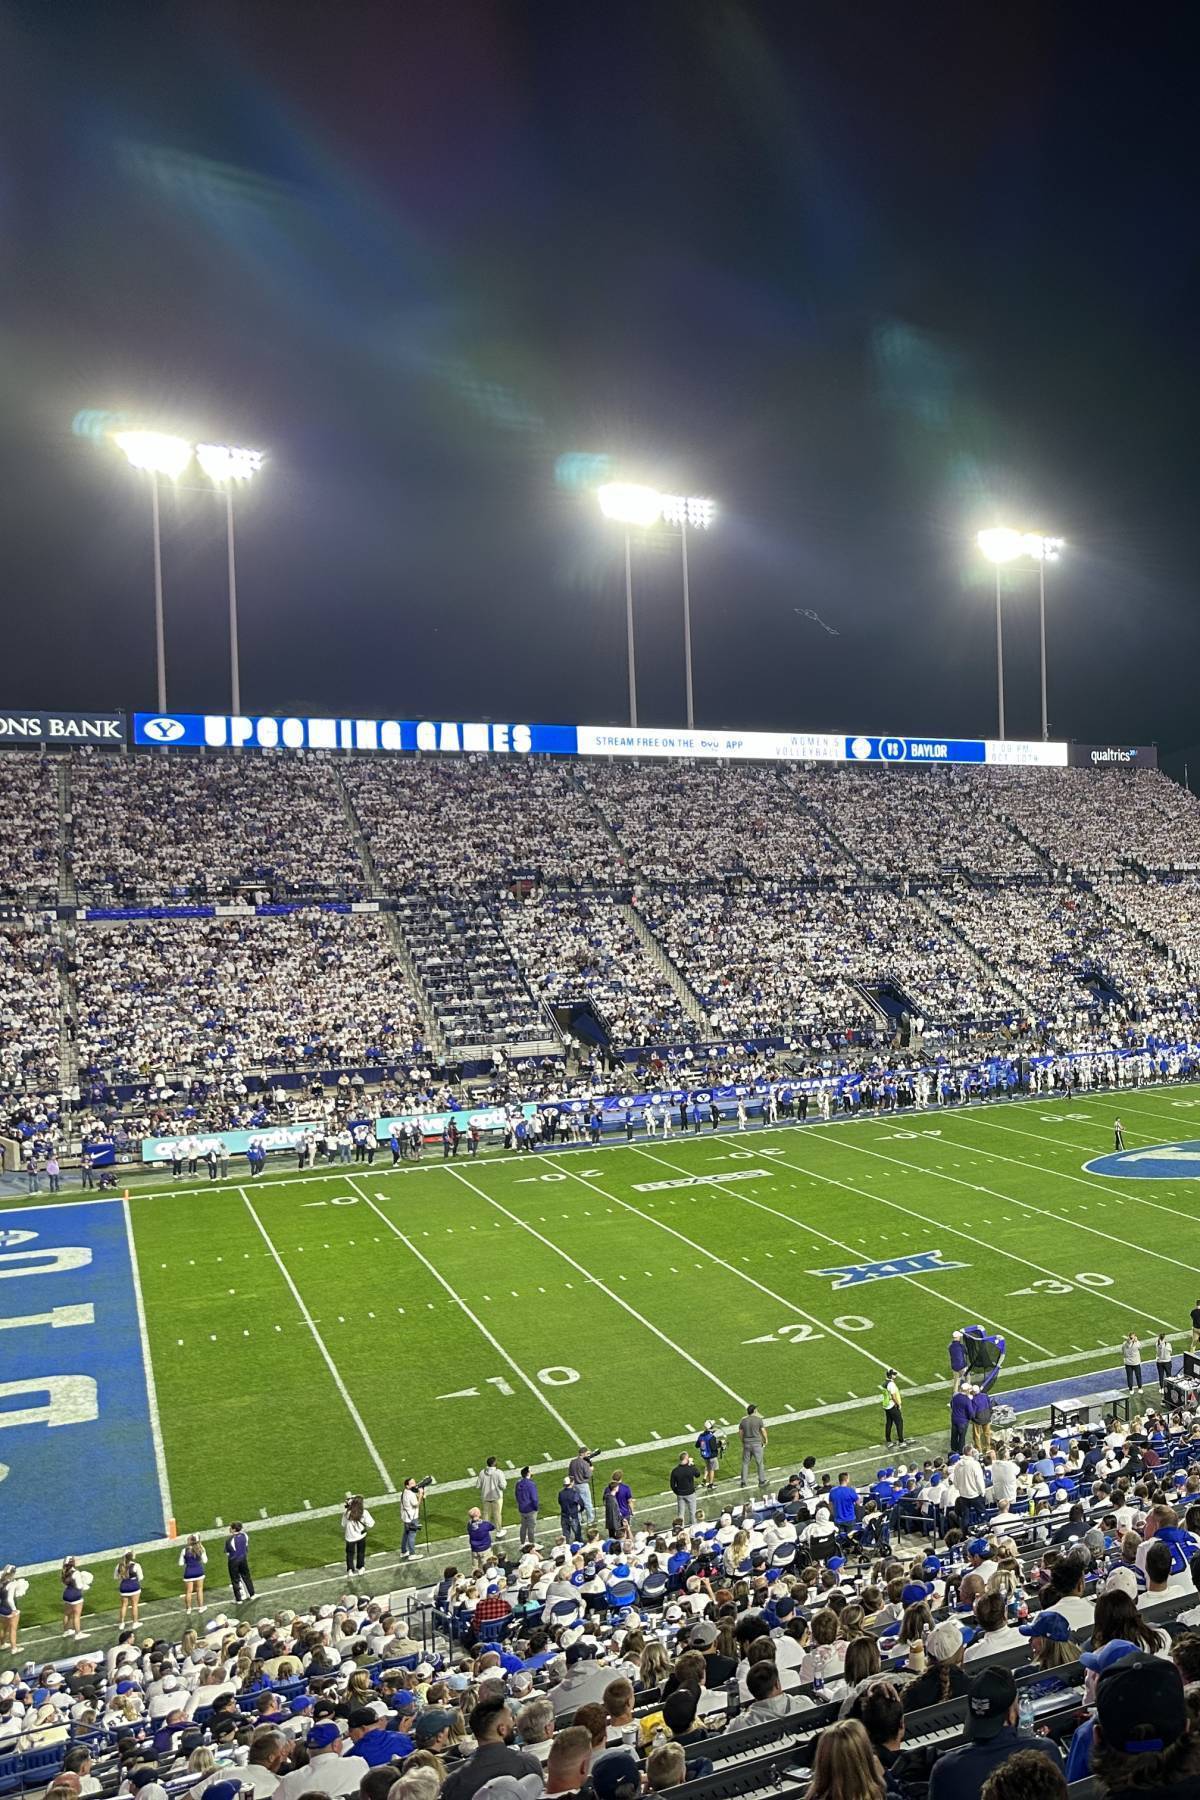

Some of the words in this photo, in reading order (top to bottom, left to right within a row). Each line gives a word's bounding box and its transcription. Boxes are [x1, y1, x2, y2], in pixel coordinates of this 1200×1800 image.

[49, 719, 123, 738] BANK
[204, 716, 401, 750] UPCOMING
[416, 722, 532, 753] GAMES
[595, 737, 634, 747] STREAM
[637, 737, 660, 748] FREE
[662, 739, 675, 748] ON
[677, 739, 694, 749] THE
[726, 740, 743, 750] APP
[791, 736, 839, 747] WOMENS
[887, 742, 898, 755] VS
[911, 743, 947, 759] BAYLOR
[1090, 747, 1131, 762] qualtrics
[735, 1084, 767, 1096] BU
[1032, 1272, 1115, 1296] 30
[782, 1315, 876, 1345] 20
[485, 1366, 581, 1397] 10
